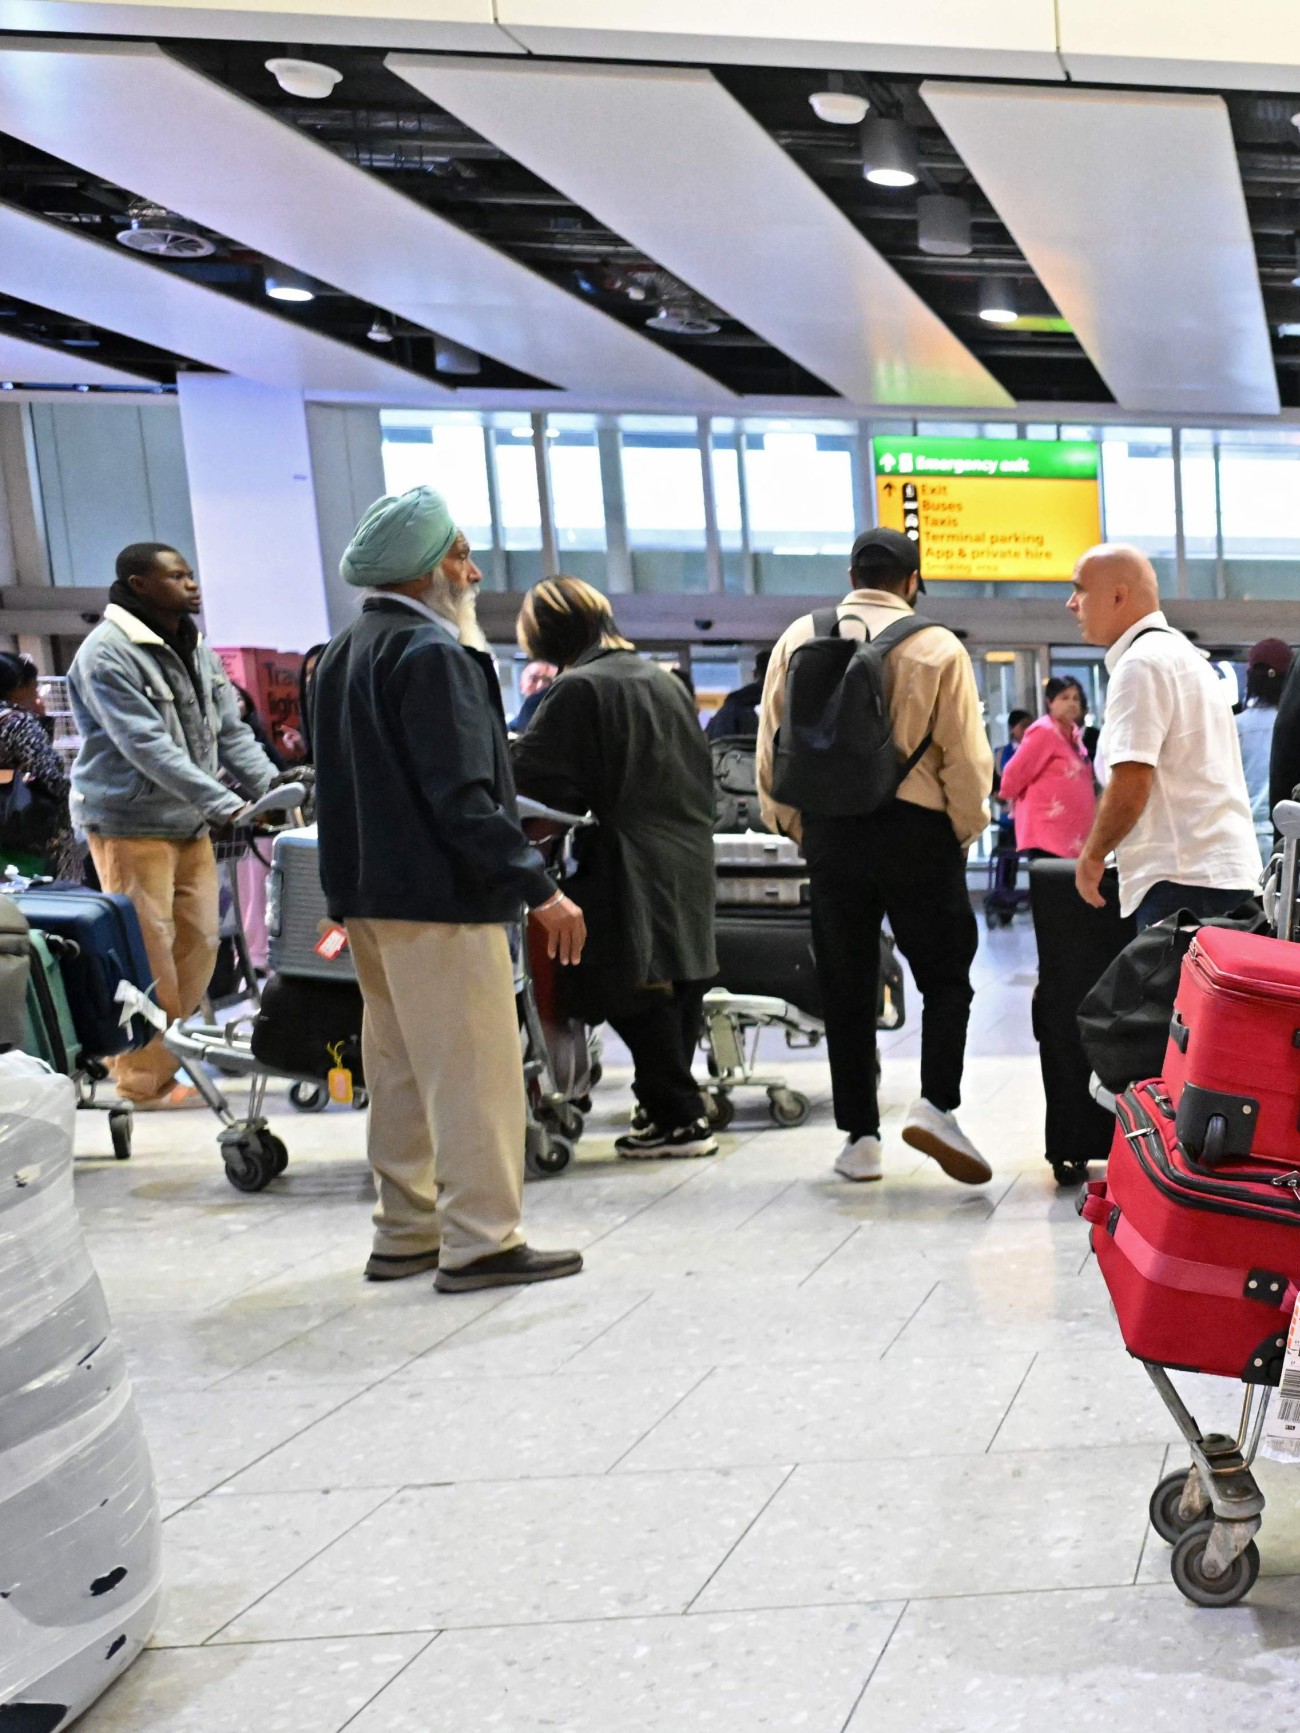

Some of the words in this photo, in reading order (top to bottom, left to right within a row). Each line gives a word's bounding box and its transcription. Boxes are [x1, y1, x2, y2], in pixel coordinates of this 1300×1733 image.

[916, 456, 998, 474] Emergency
[1000, 457, 1030, 473] exit
[921, 484, 948, 497] Exit
[922, 500, 963, 512] Buses
[923, 515, 959, 528] Taxis
[925, 531, 986, 543] Terminal
[990, 532, 1044, 547] parking
[925, 547, 955, 560] App
[971, 548, 1020, 561] private
[1025, 548, 1053, 560] hire
